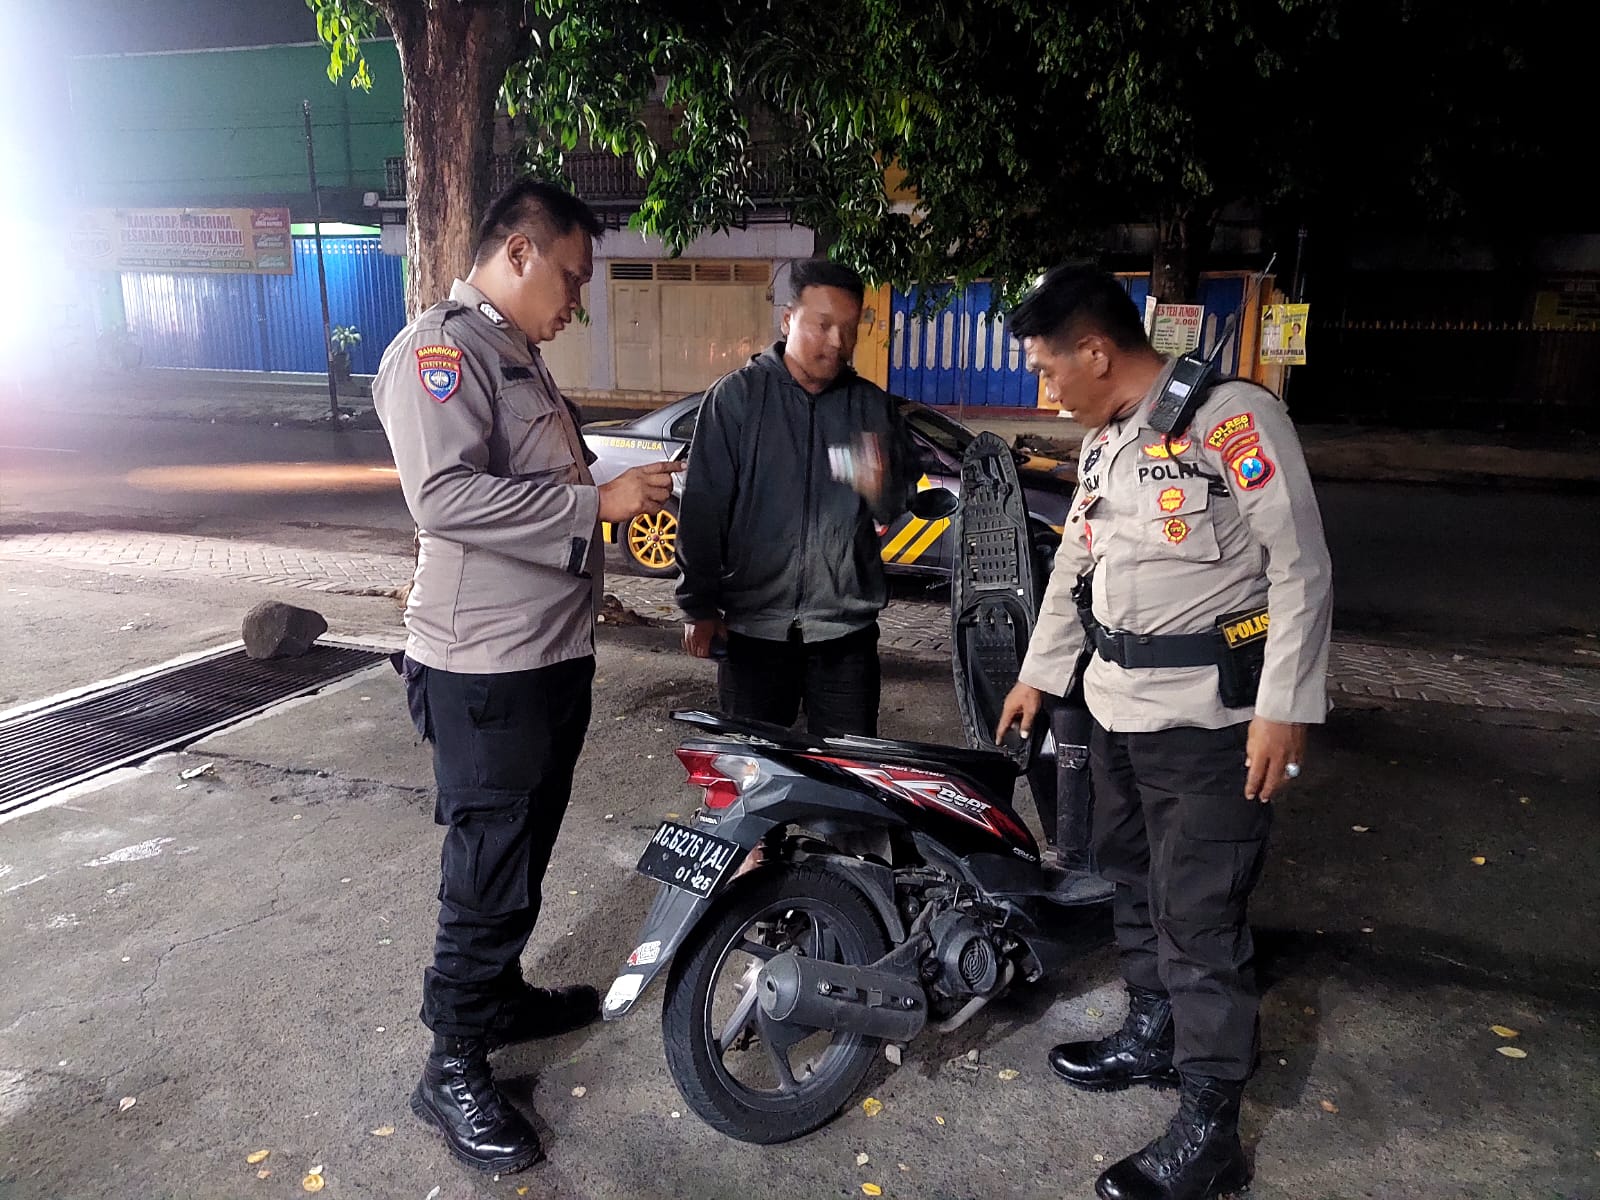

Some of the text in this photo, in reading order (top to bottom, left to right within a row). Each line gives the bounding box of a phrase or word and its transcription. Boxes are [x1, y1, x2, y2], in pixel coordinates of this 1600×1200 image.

[126, 215, 233, 229] KAMI SIAP MENERIMA
[121, 230, 165, 243] PESANAN
[166, 230, 192, 243] 1000
[1157, 306, 1199, 318] ES TEH JUMBO
[1208, 414, 1249, 446] POLRES
[637, 441, 662, 450] PULSA
